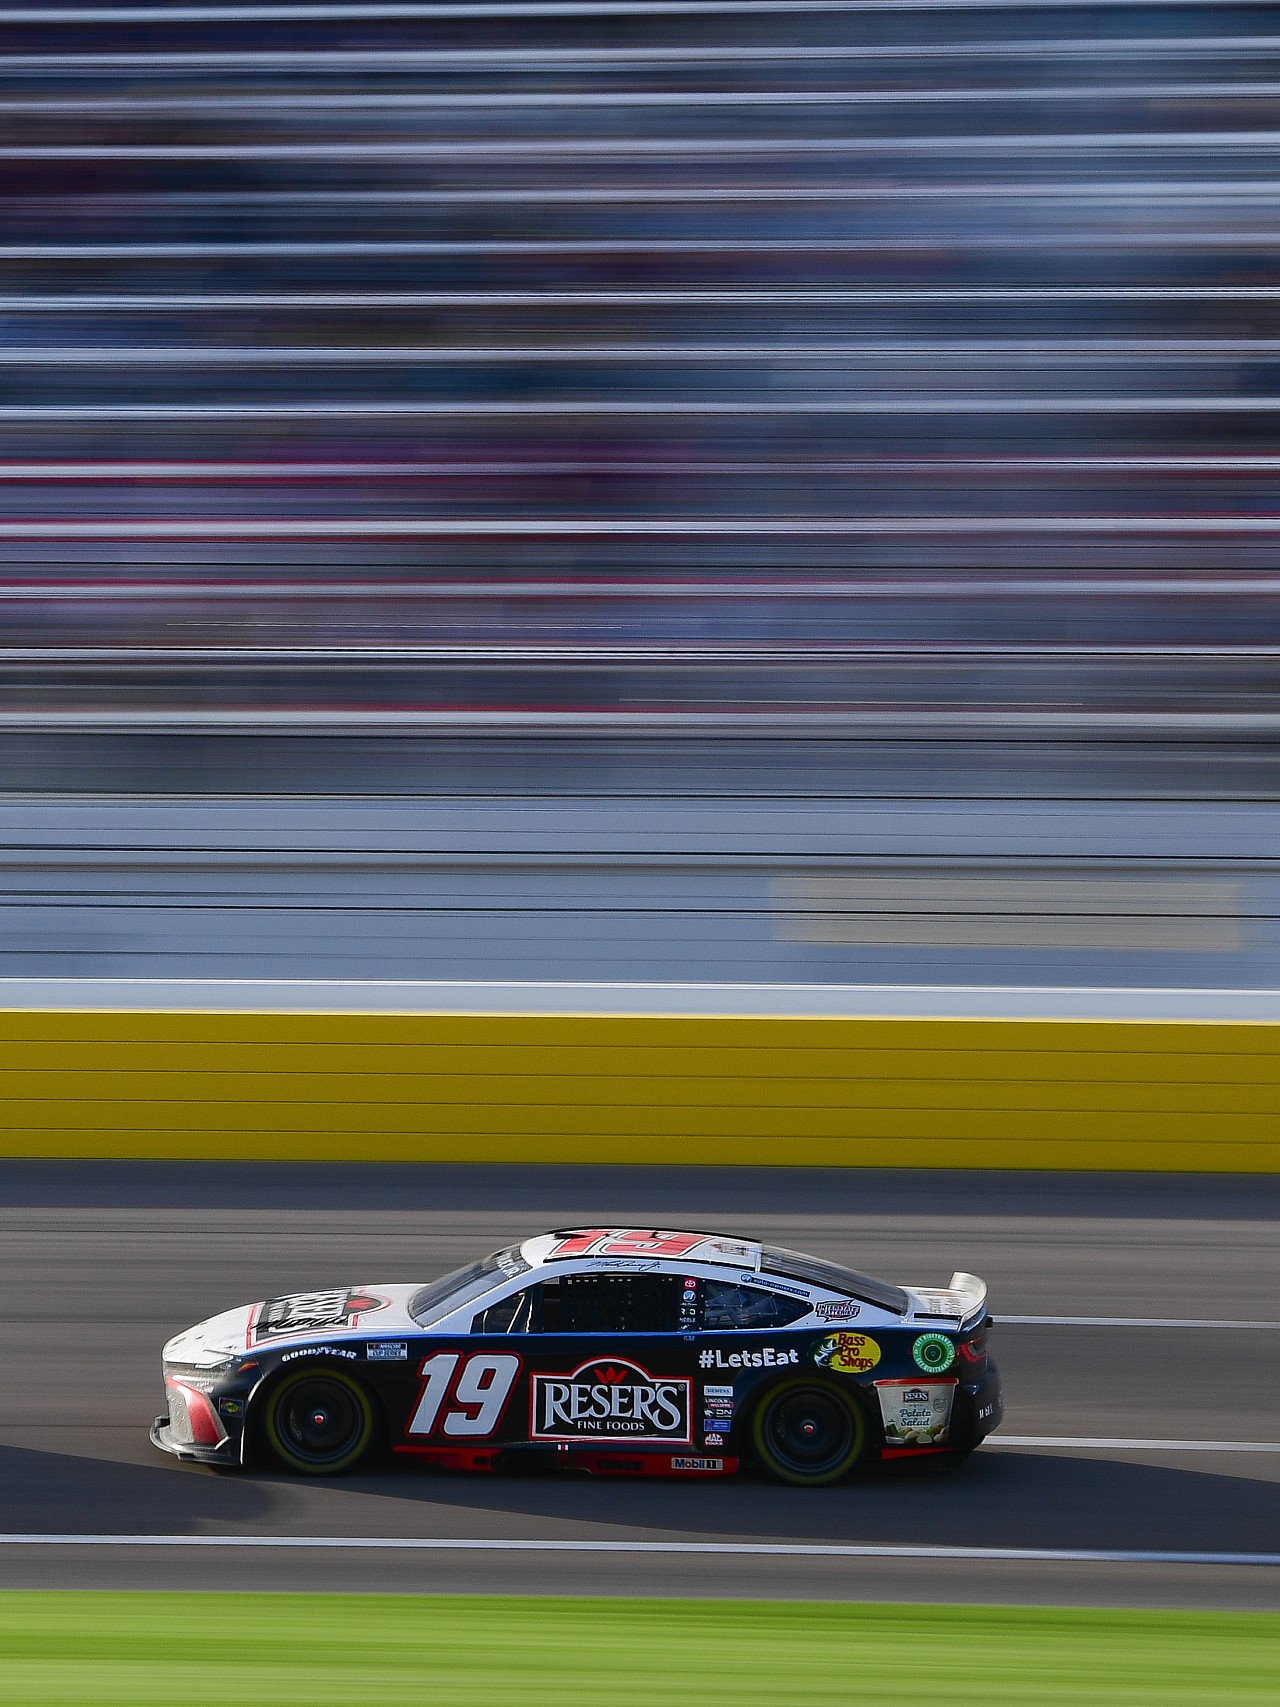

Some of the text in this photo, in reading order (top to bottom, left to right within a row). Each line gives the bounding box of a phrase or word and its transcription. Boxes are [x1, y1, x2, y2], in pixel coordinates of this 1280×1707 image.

[838, 1333, 866, 1346] Bass
[281, 1345, 357, 1361] GOODYEAR
[840, 1345, 860, 1356] Pro
[699, 1347, 800, 1368] #LetsEat
[839, 1355, 874, 1371] Shops
[408, 1353, 518, 1436] 19
[543, 1382, 681, 1432] RESER'S
[899, 1408, 932, 1417] Potato
[577, 1420, 645, 1431] FINE FOODS
[900, 1418, 930, 1427] Salad
[675, 1459, 717, 1470] Mobil 1
